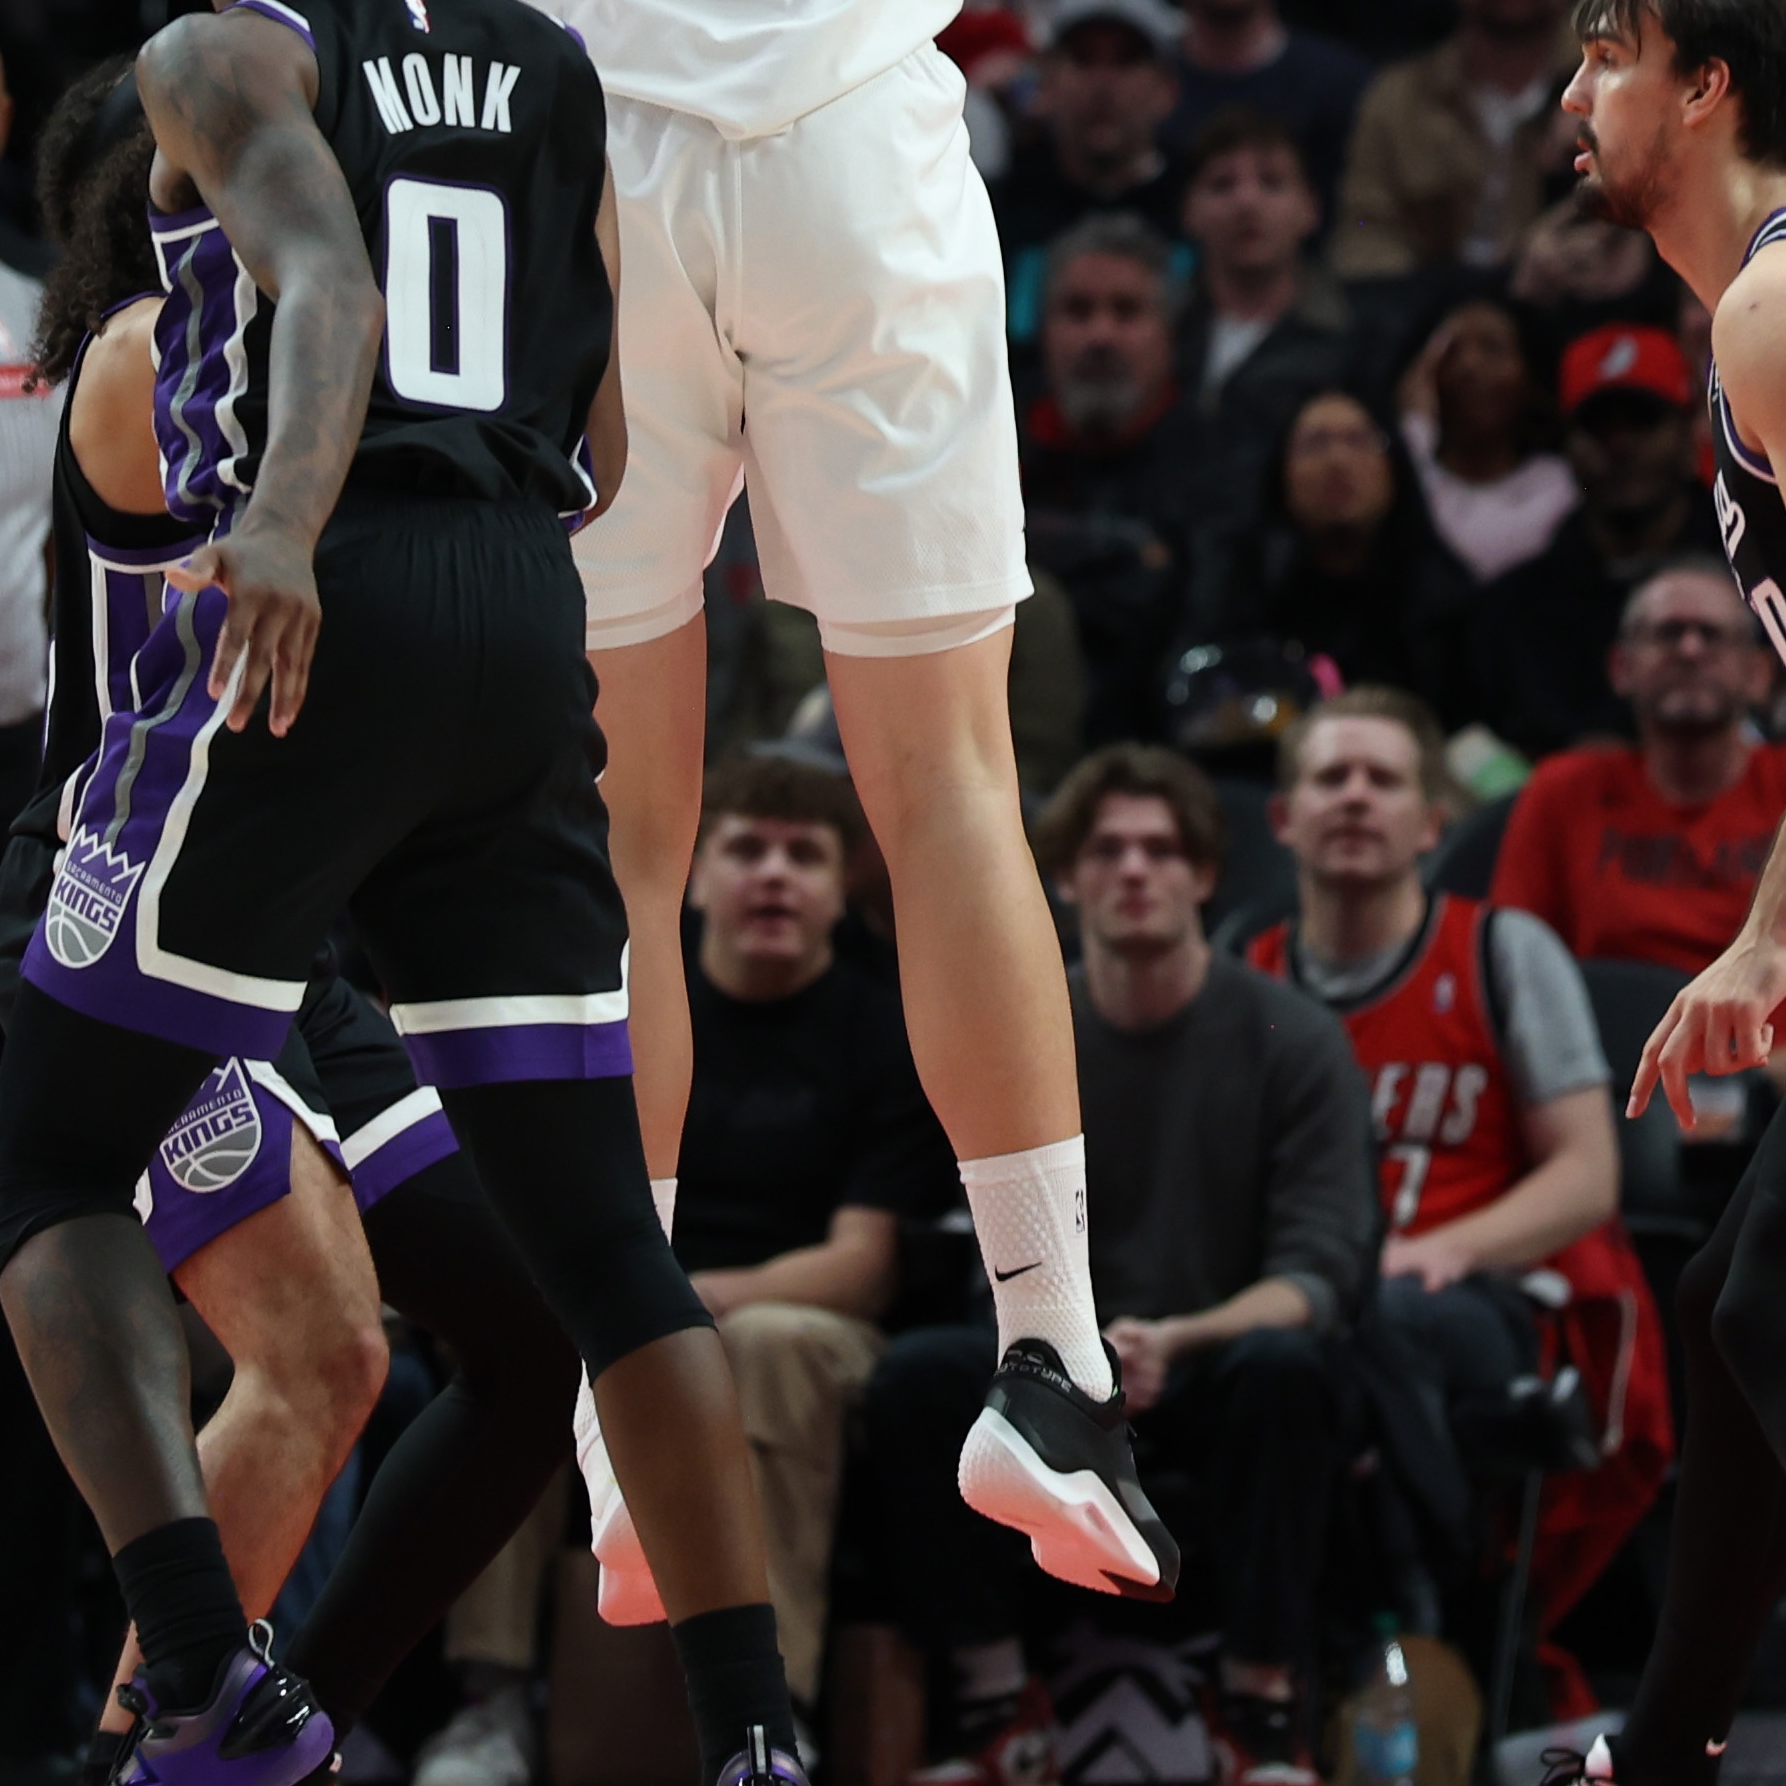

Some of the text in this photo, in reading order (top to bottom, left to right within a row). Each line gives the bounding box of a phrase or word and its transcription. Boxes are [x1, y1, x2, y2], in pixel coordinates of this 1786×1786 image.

[362, 51, 522, 135] MONK
[384, 171, 514, 414] 0
[55, 874, 120, 934] KINGS
[162, 1101, 256, 1166] KINGS
